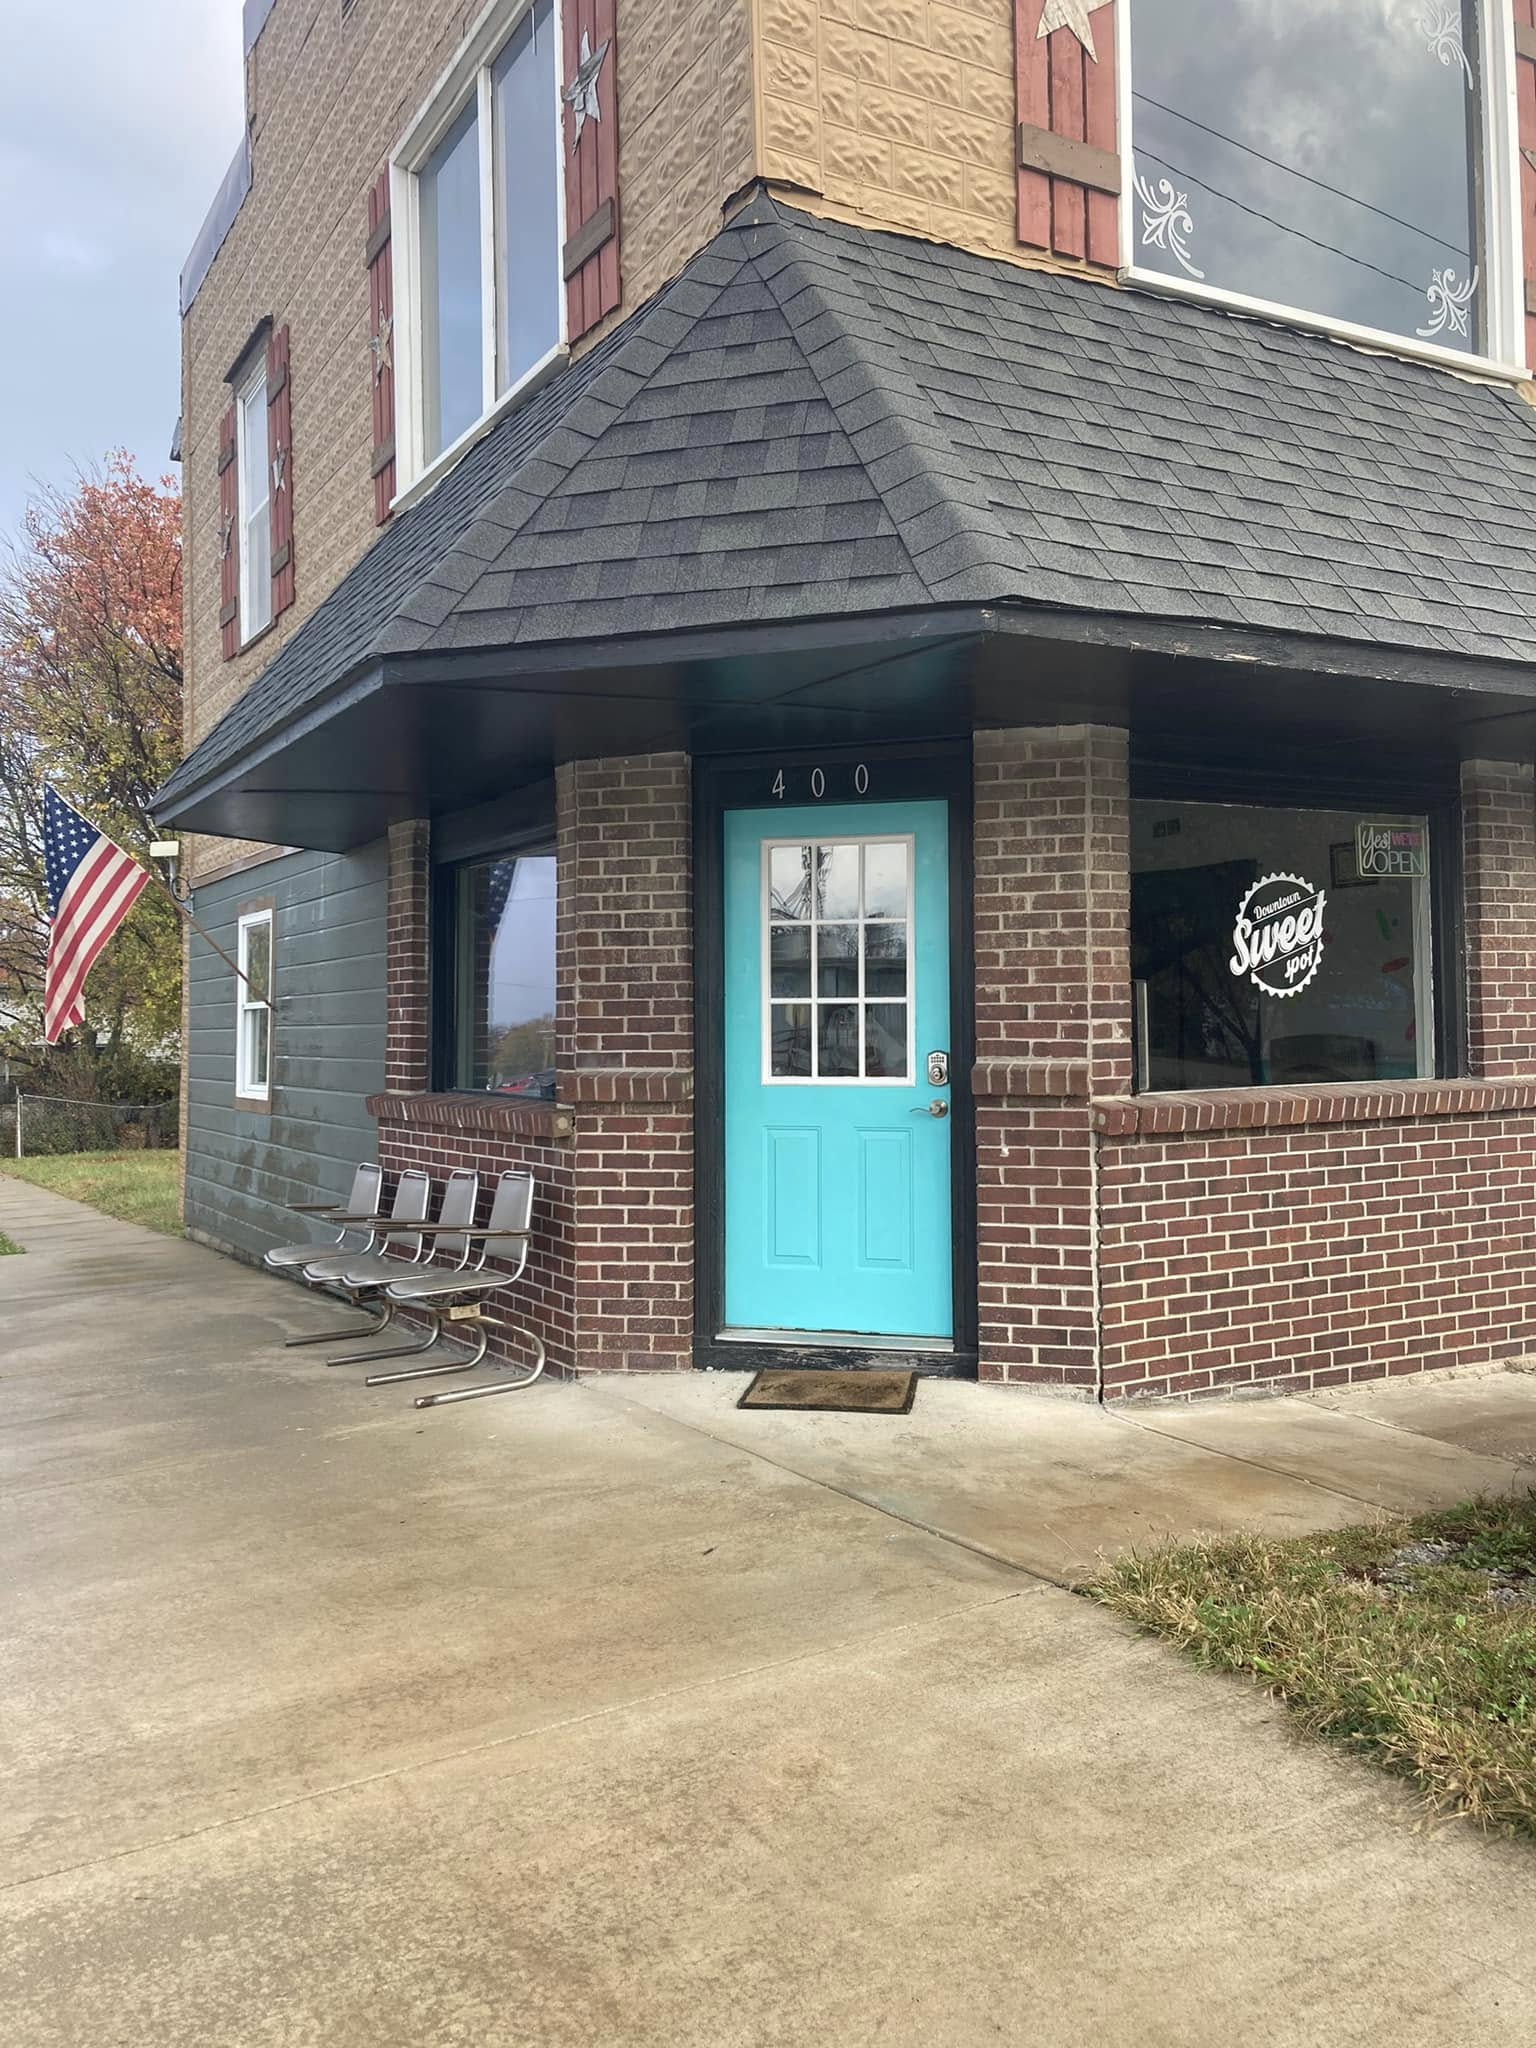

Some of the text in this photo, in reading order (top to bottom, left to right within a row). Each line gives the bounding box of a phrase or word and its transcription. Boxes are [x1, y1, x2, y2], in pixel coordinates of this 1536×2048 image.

[771, 764, 869, 799] 400
[1373, 850, 1424, 873] OPEN
[1253, 892, 1301, 919] Downtown
[1230, 889, 1327, 976] Sweet
[1284, 945, 1314, 984] spot
